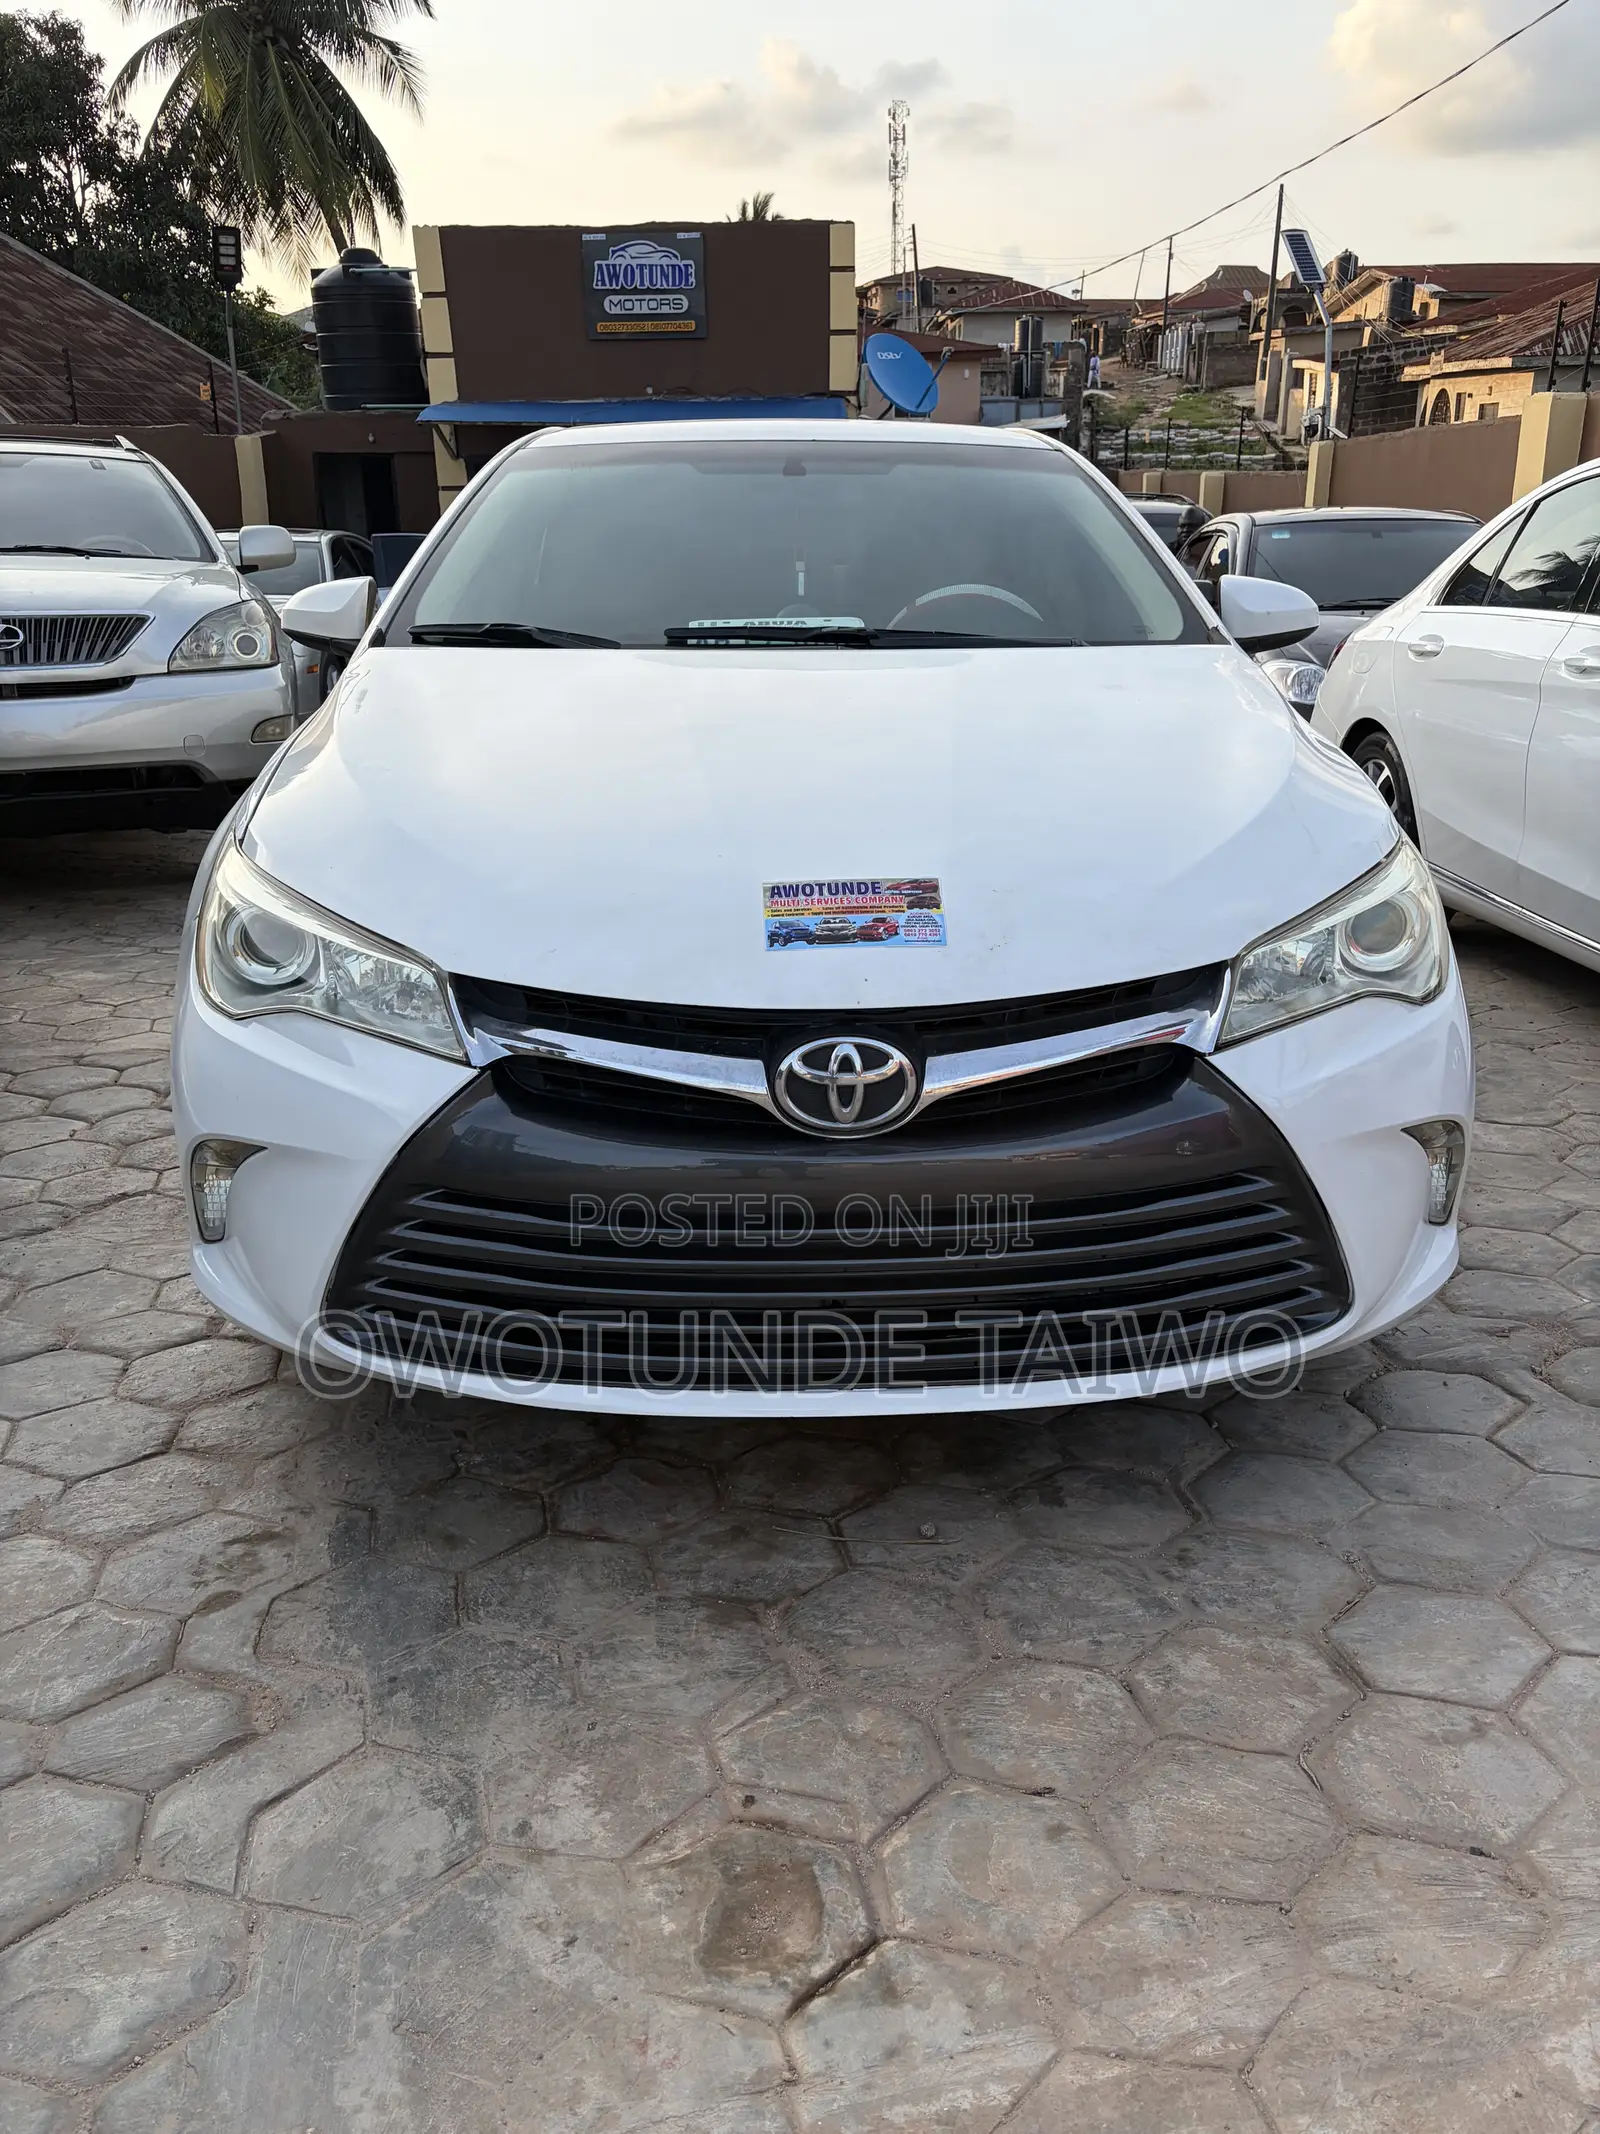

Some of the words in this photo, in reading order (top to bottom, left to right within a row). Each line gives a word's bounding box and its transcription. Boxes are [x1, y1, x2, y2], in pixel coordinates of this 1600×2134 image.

[594, 262, 695, 289] AWOTUNDE
[609, 298, 684, 311] MOTORS
[770, 881, 882, 898] AWOTUNDE
[771, 899, 800, 907] MULTI
[804, 897, 851, 905] SERVICES
[855, 896, 904, 904] COMPANY
